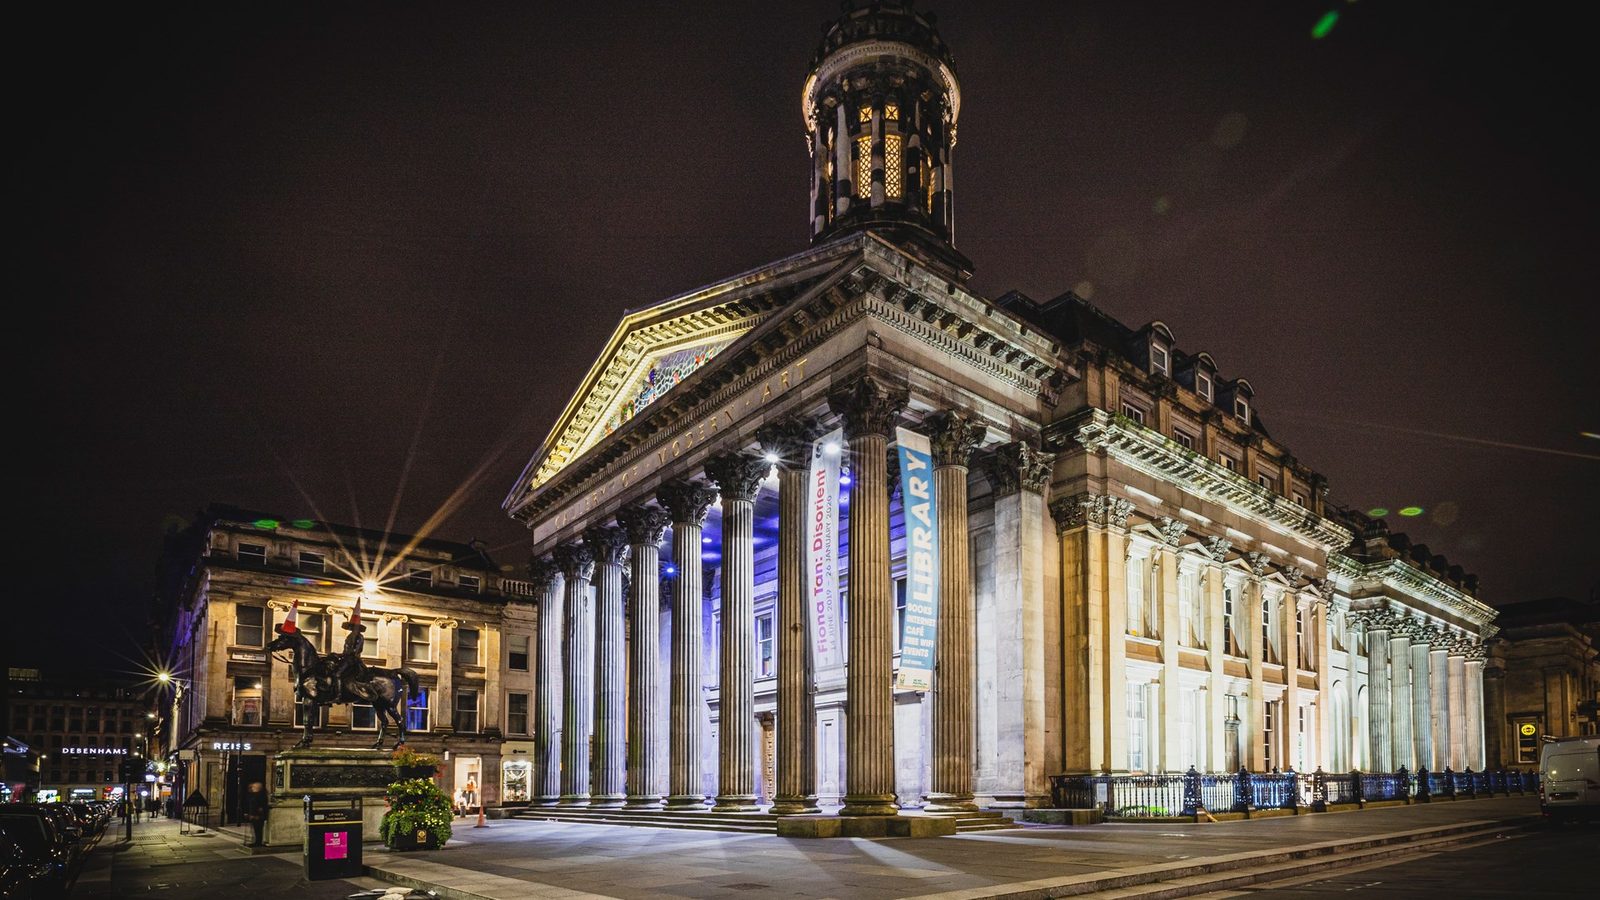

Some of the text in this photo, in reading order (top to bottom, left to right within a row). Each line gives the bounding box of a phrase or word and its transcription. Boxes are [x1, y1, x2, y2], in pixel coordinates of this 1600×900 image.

[761, 358, 808, 403] ART
[906, 450, 933, 603] LIBRARY
[813, 469, 828, 653] Fiona Tan: Disorient
[825, 565, 832, 577] 26
[907, 603, 932, 615] BOOKS
[827, 613, 835, 637] JUNE
[905, 626, 924, 637] CAFÉ
[903, 646, 929, 657] EVENTS
[62, 747, 128, 755] DEBENHAMS
[213, 742, 251, 750] REISS
